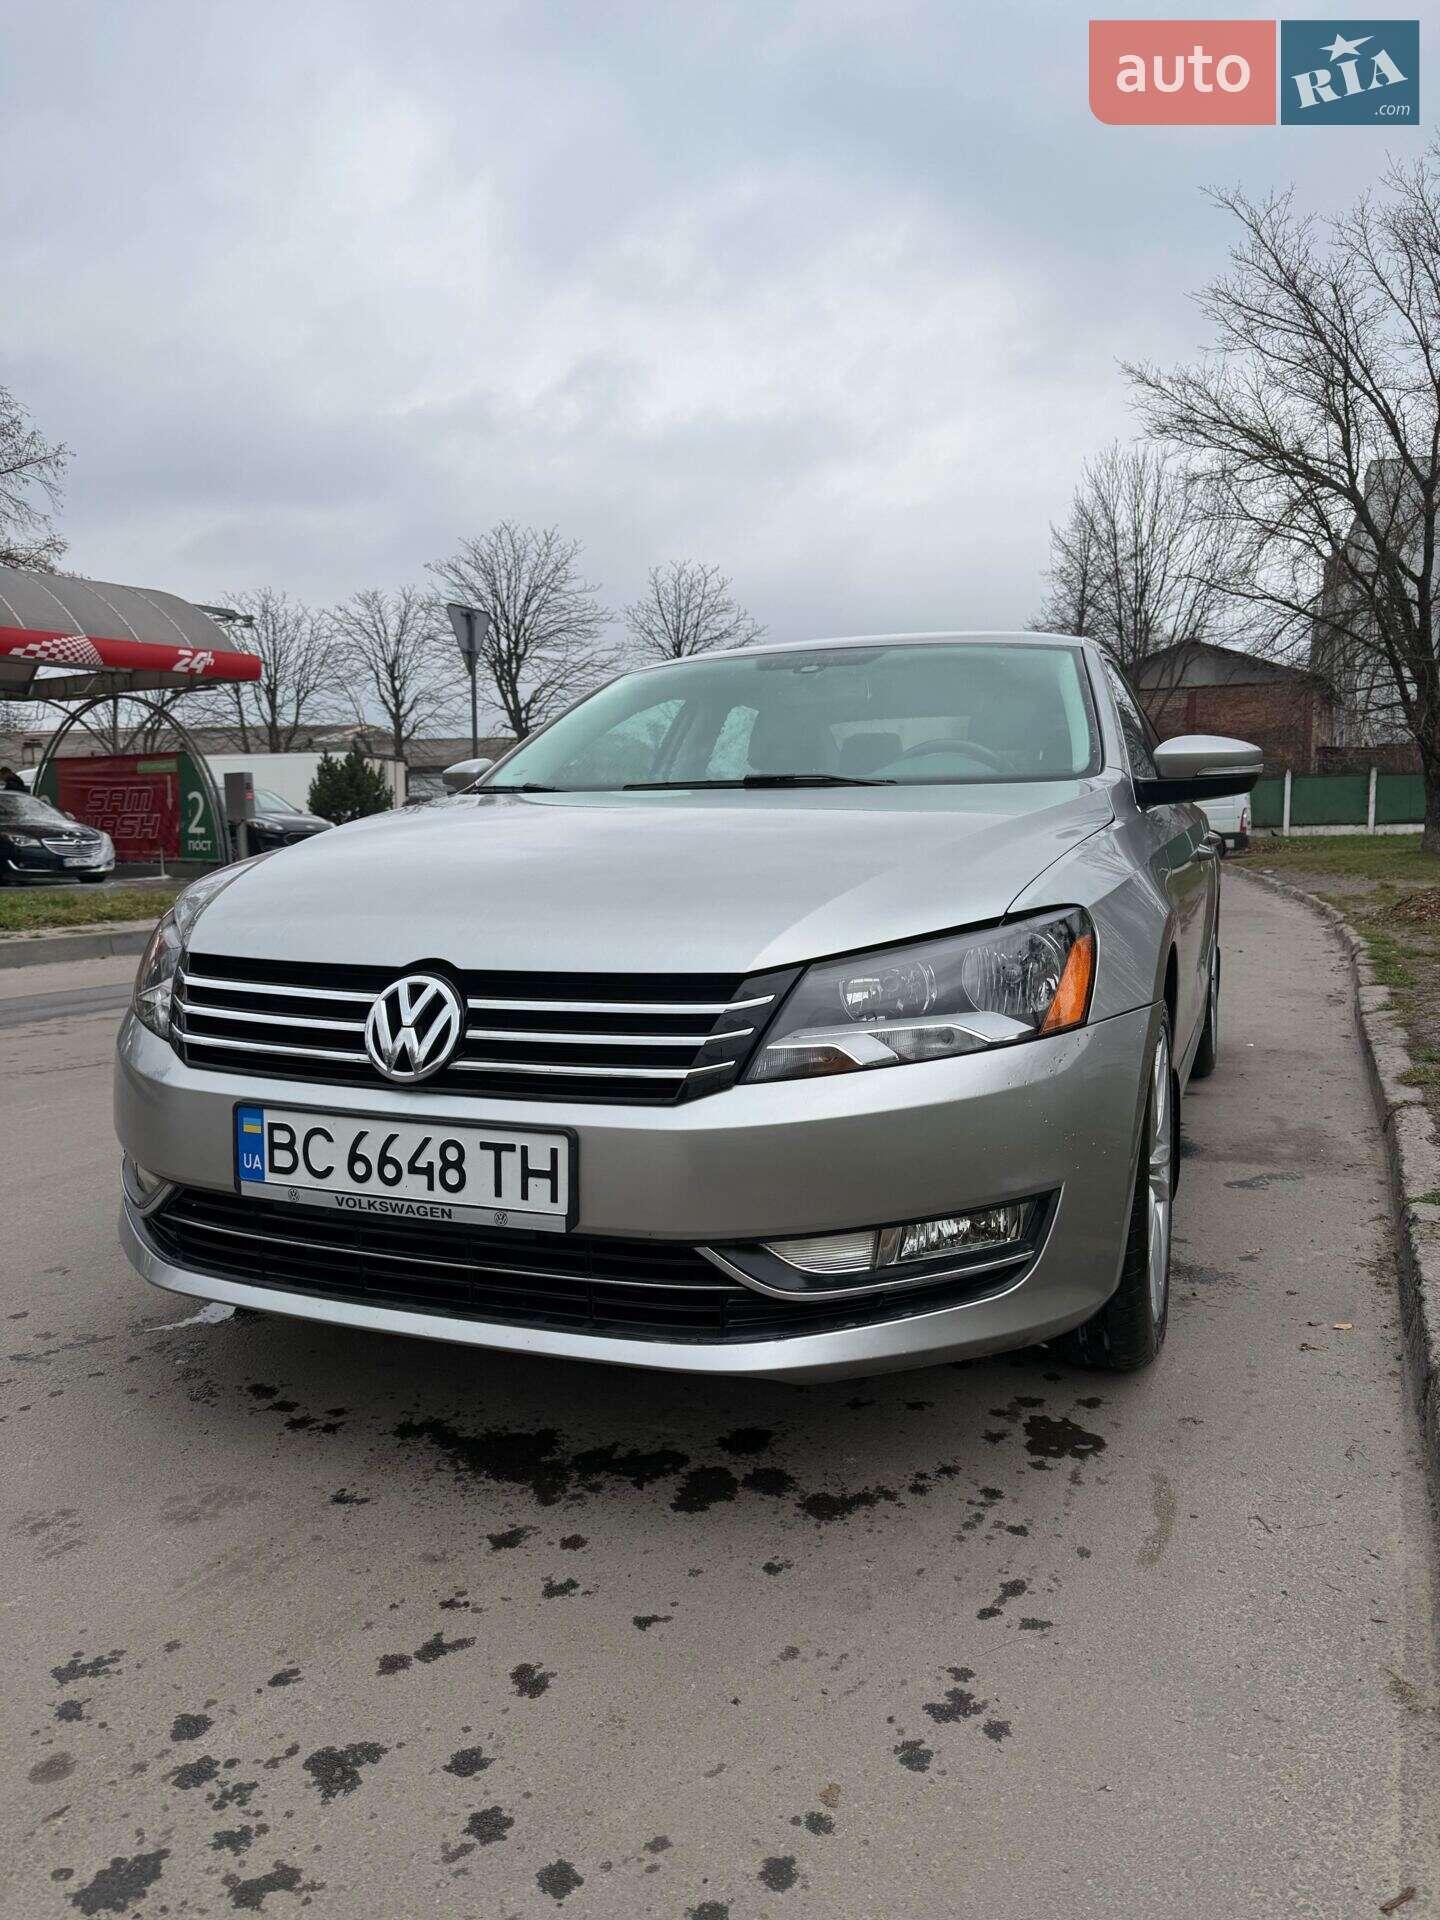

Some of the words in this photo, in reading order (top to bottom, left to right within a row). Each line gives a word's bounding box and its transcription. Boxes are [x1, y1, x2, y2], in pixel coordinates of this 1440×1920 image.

[86, 786, 153, 812] SAM
[187, 791, 206, 834] 2
[243, 1152, 262, 1171] UA
[267, 1121, 335, 1180] BC
[347, 1130, 467, 1194] 6648
[479, 1141, 559, 1204] TH
[335, 1195, 453, 1220] VOLKSWAGEN
